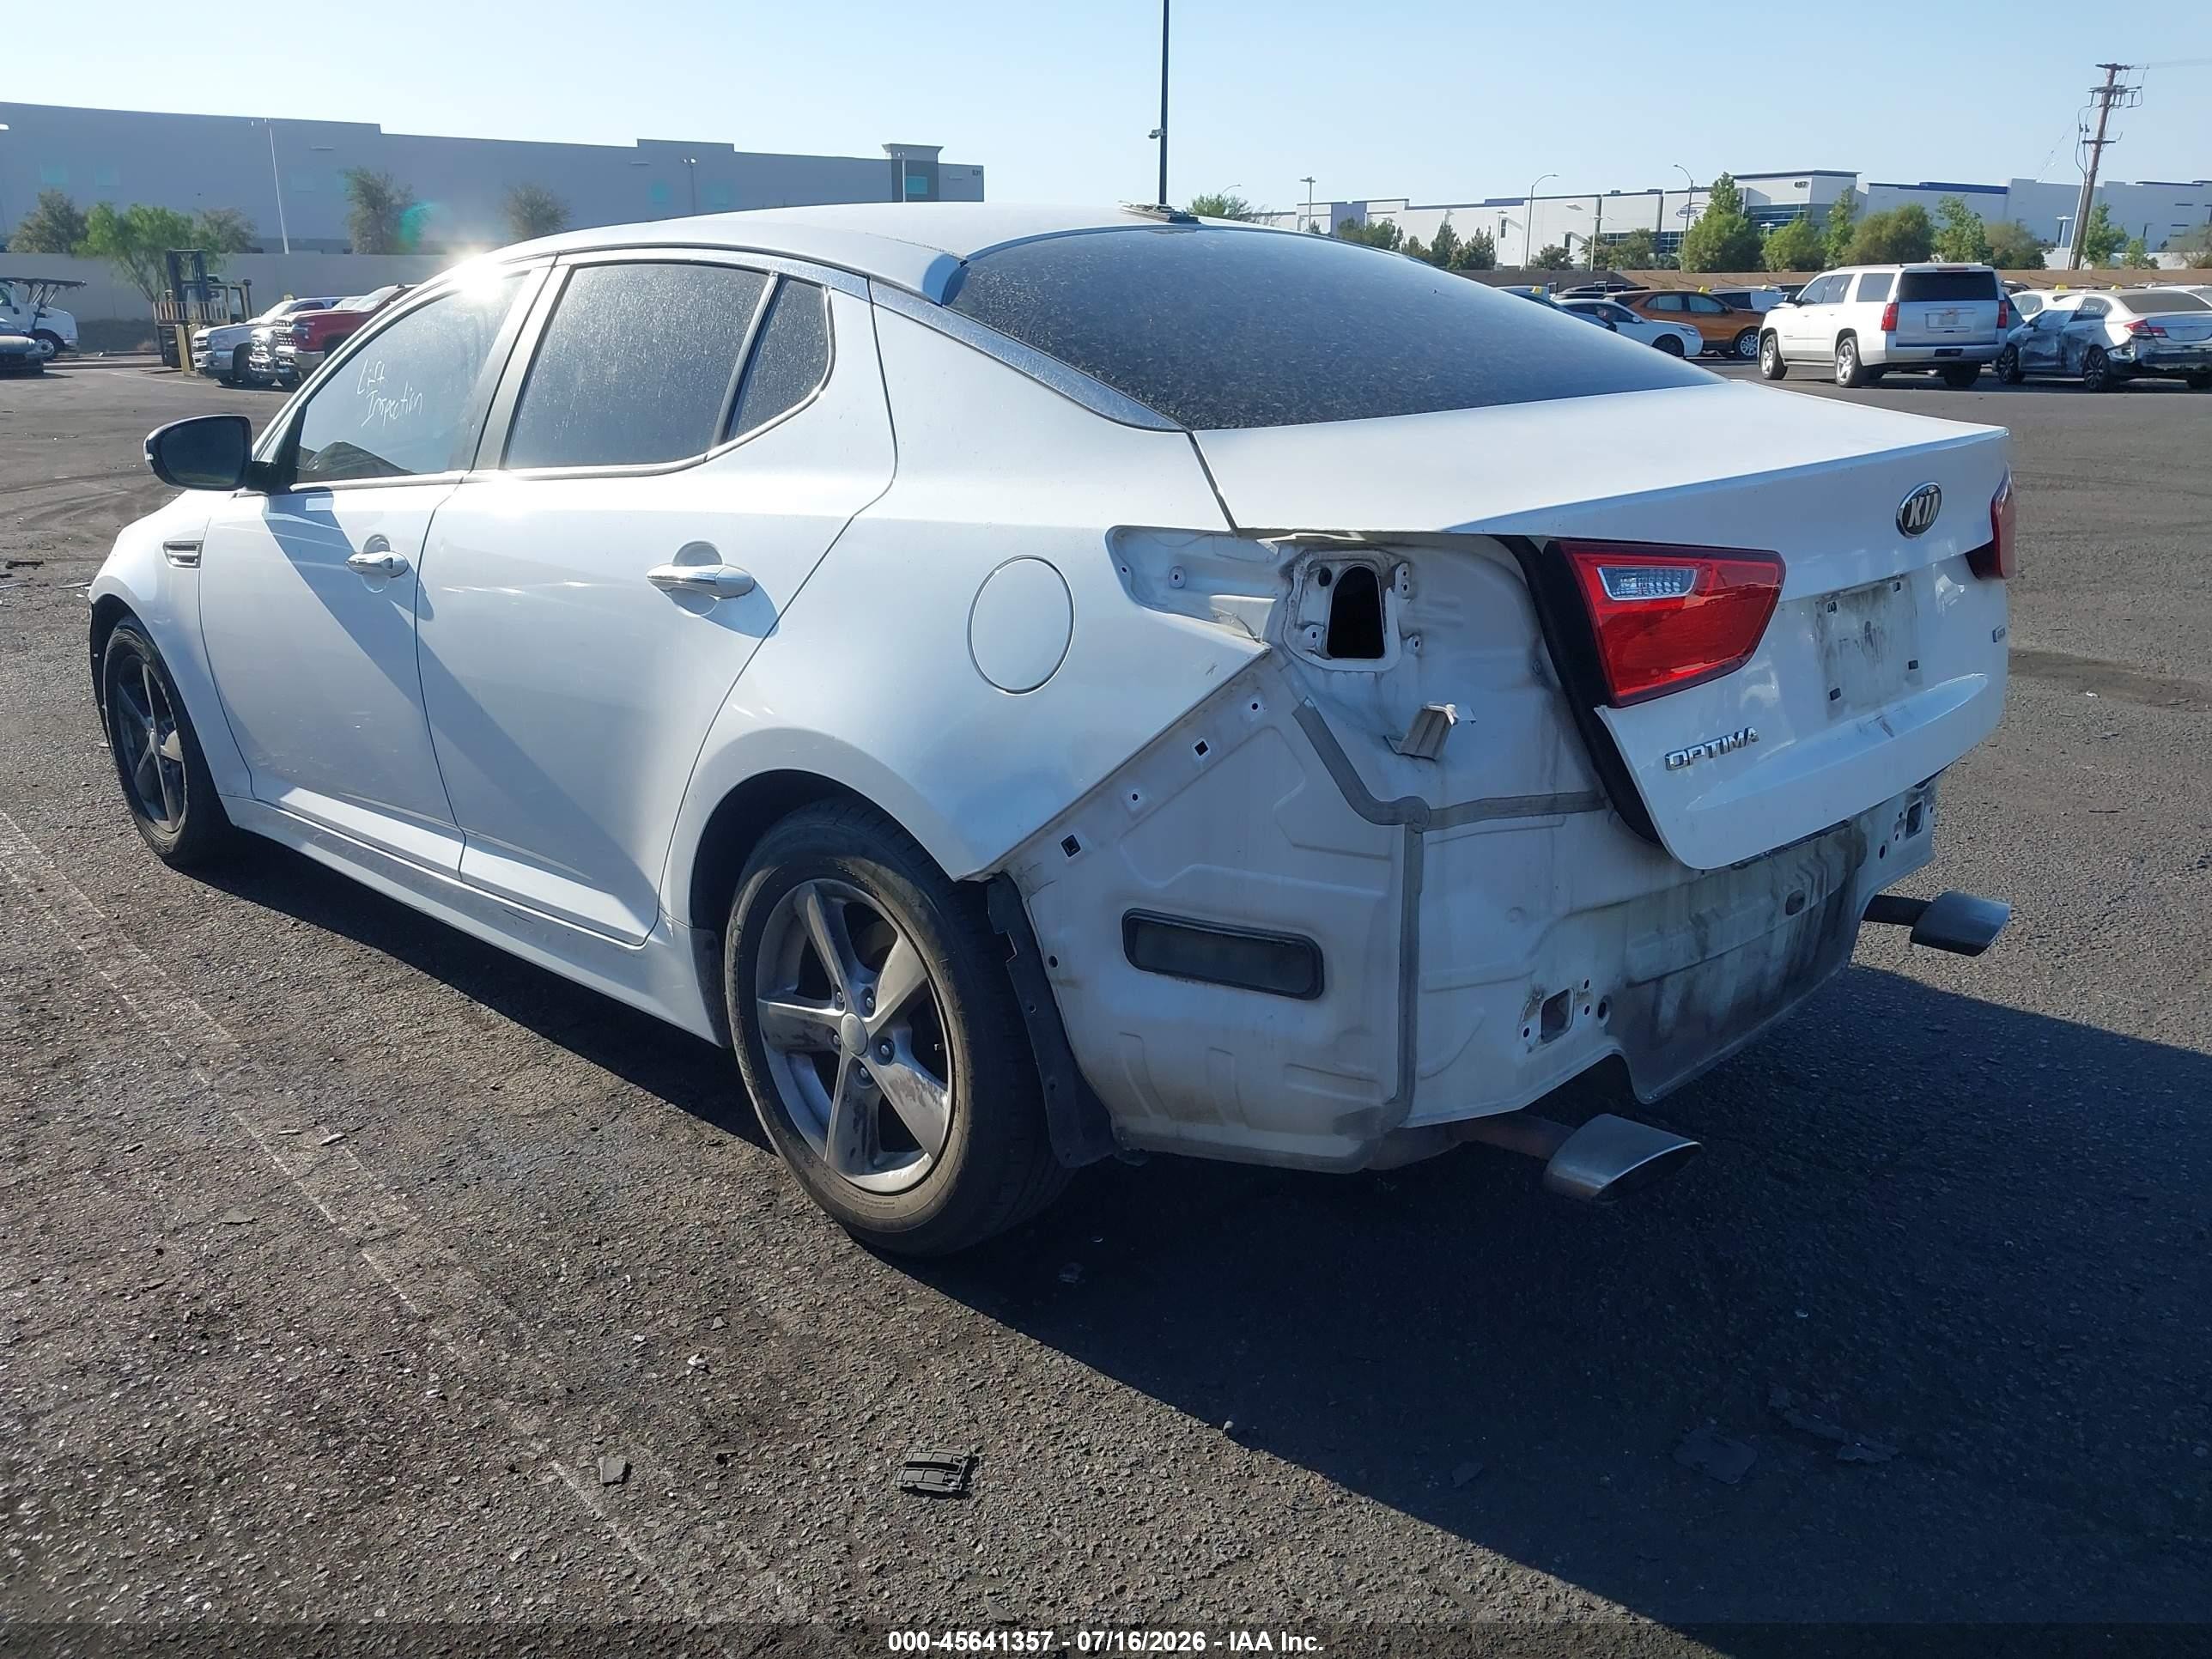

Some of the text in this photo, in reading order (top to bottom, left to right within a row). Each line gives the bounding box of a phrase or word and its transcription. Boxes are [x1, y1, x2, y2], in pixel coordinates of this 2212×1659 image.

[356, 358, 386, 394] Lift
[1906, 492, 1939, 527] KIA
[1664, 726, 1759, 770] OPTIMA
